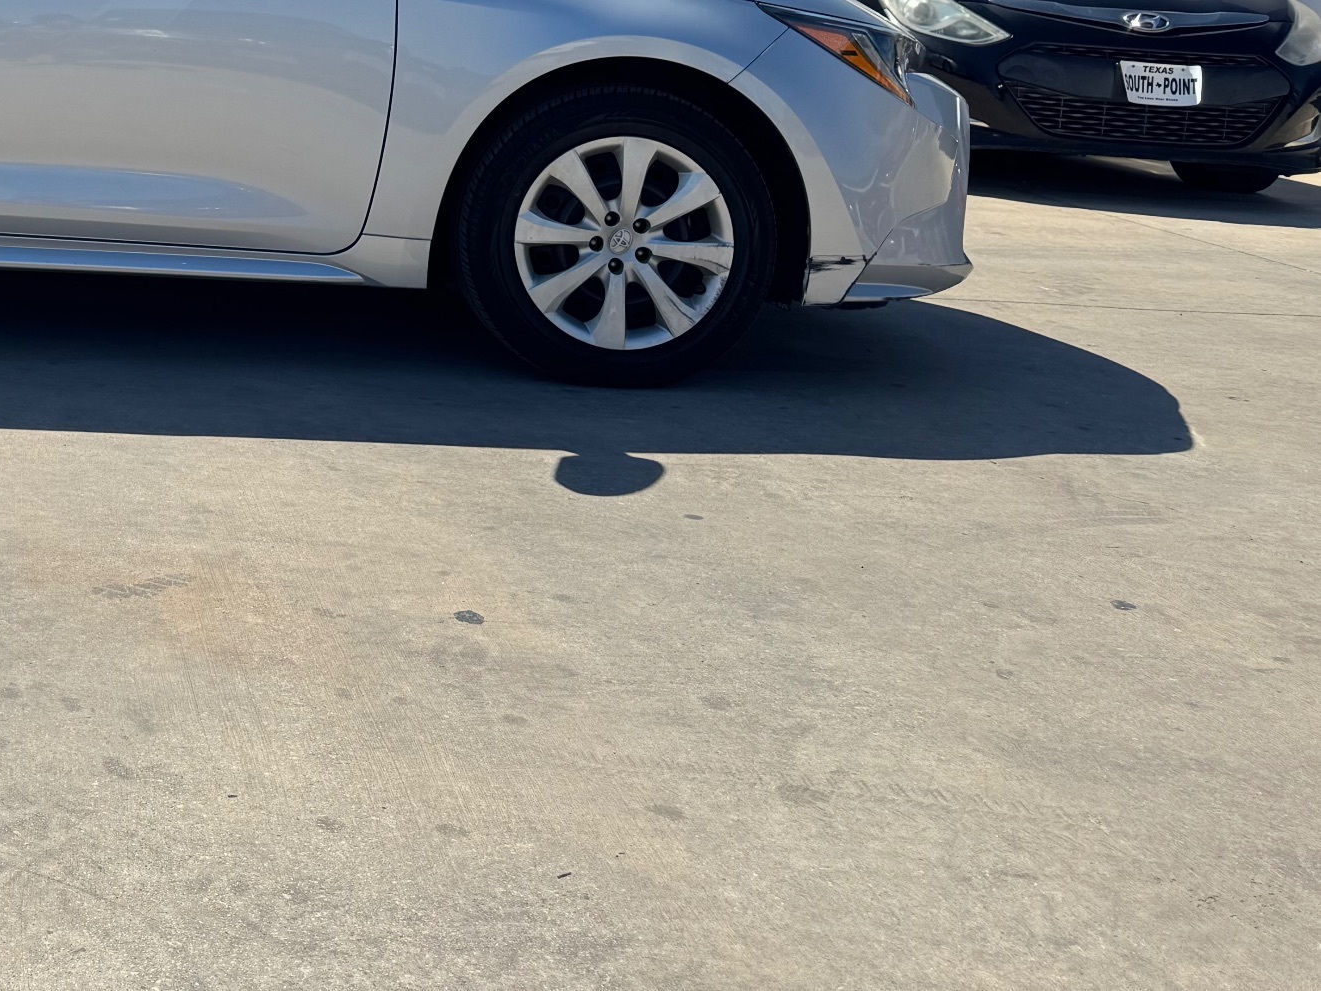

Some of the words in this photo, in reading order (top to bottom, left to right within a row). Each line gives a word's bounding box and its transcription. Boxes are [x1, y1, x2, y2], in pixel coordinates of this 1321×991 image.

[1142, 65, 1174, 75] TEXAS
[1124, 73, 1155, 94] SOUTH
[1163, 77, 1198, 96] POINT
